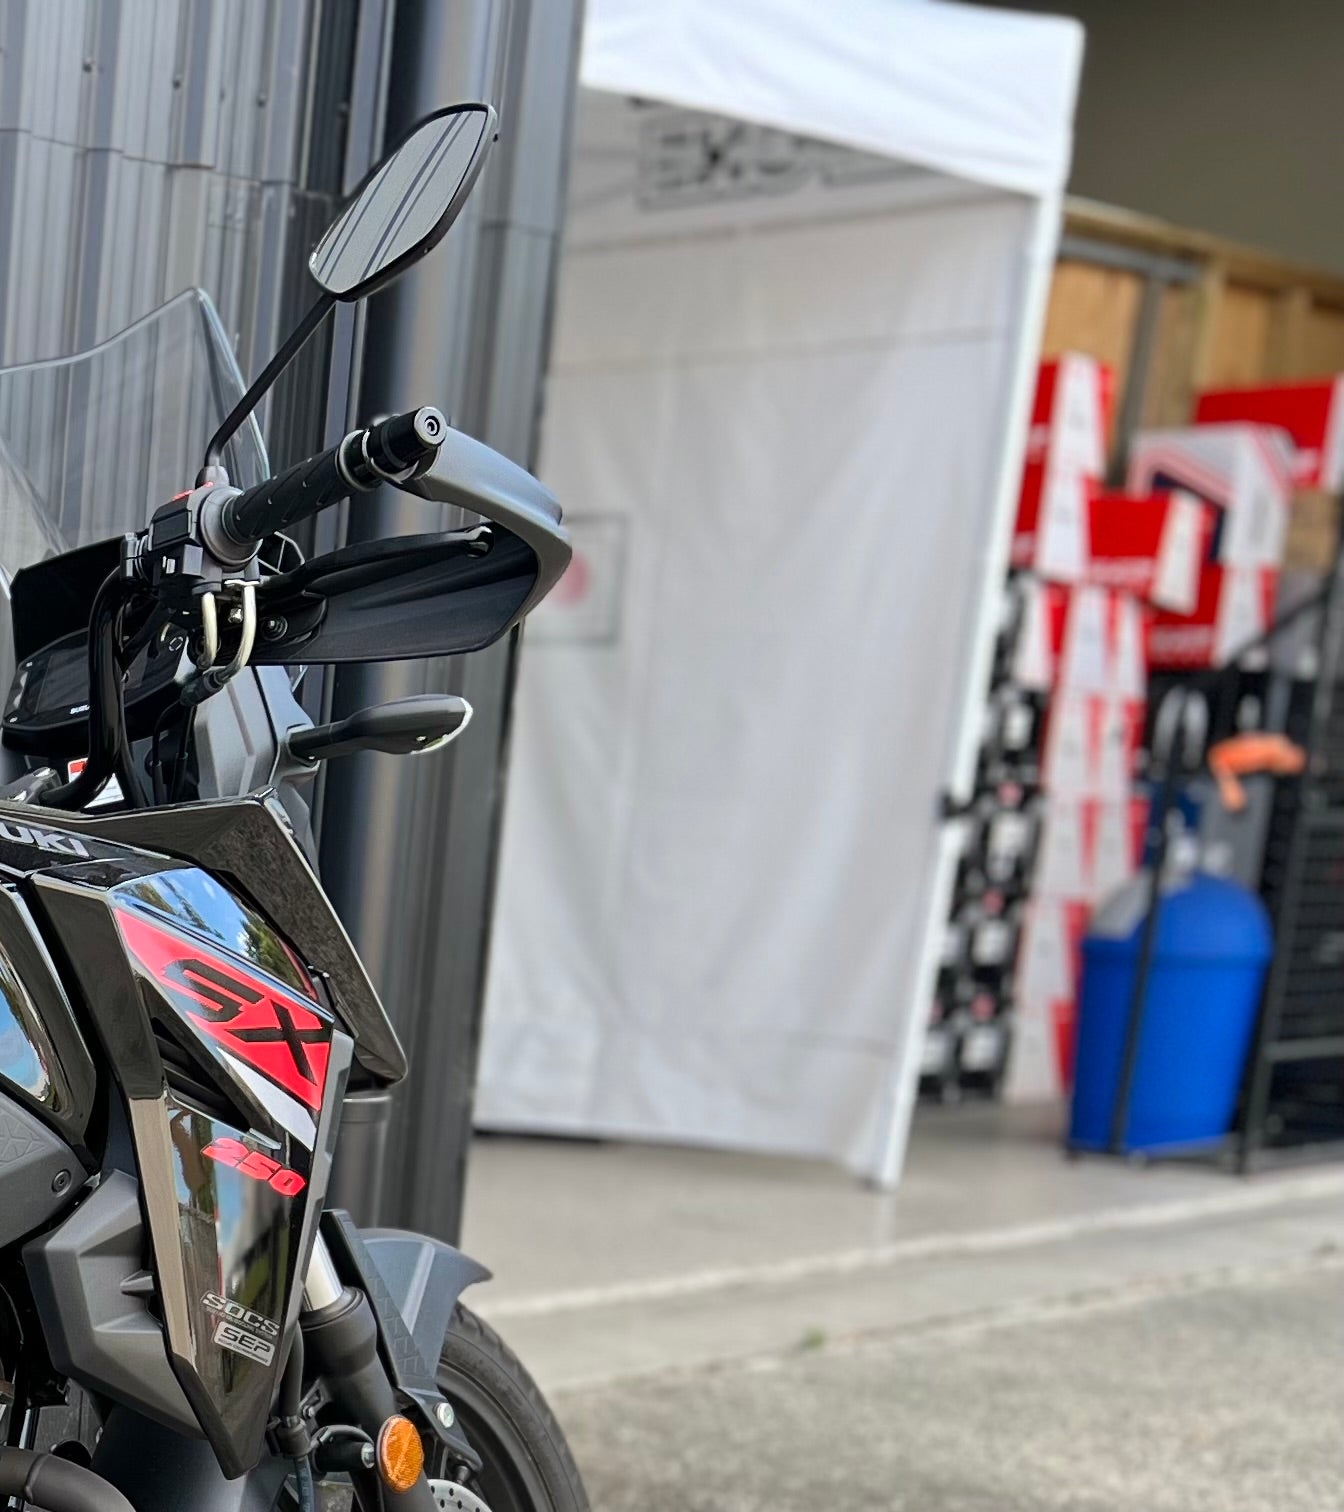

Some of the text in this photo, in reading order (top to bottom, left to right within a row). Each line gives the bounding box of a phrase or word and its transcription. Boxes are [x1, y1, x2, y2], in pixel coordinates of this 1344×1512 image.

[161, 958, 333, 1087] SX
[200, 1136, 307, 1197] 250
[202, 1293, 280, 1336] SOCS
[221, 1326, 271, 1353] SEP
